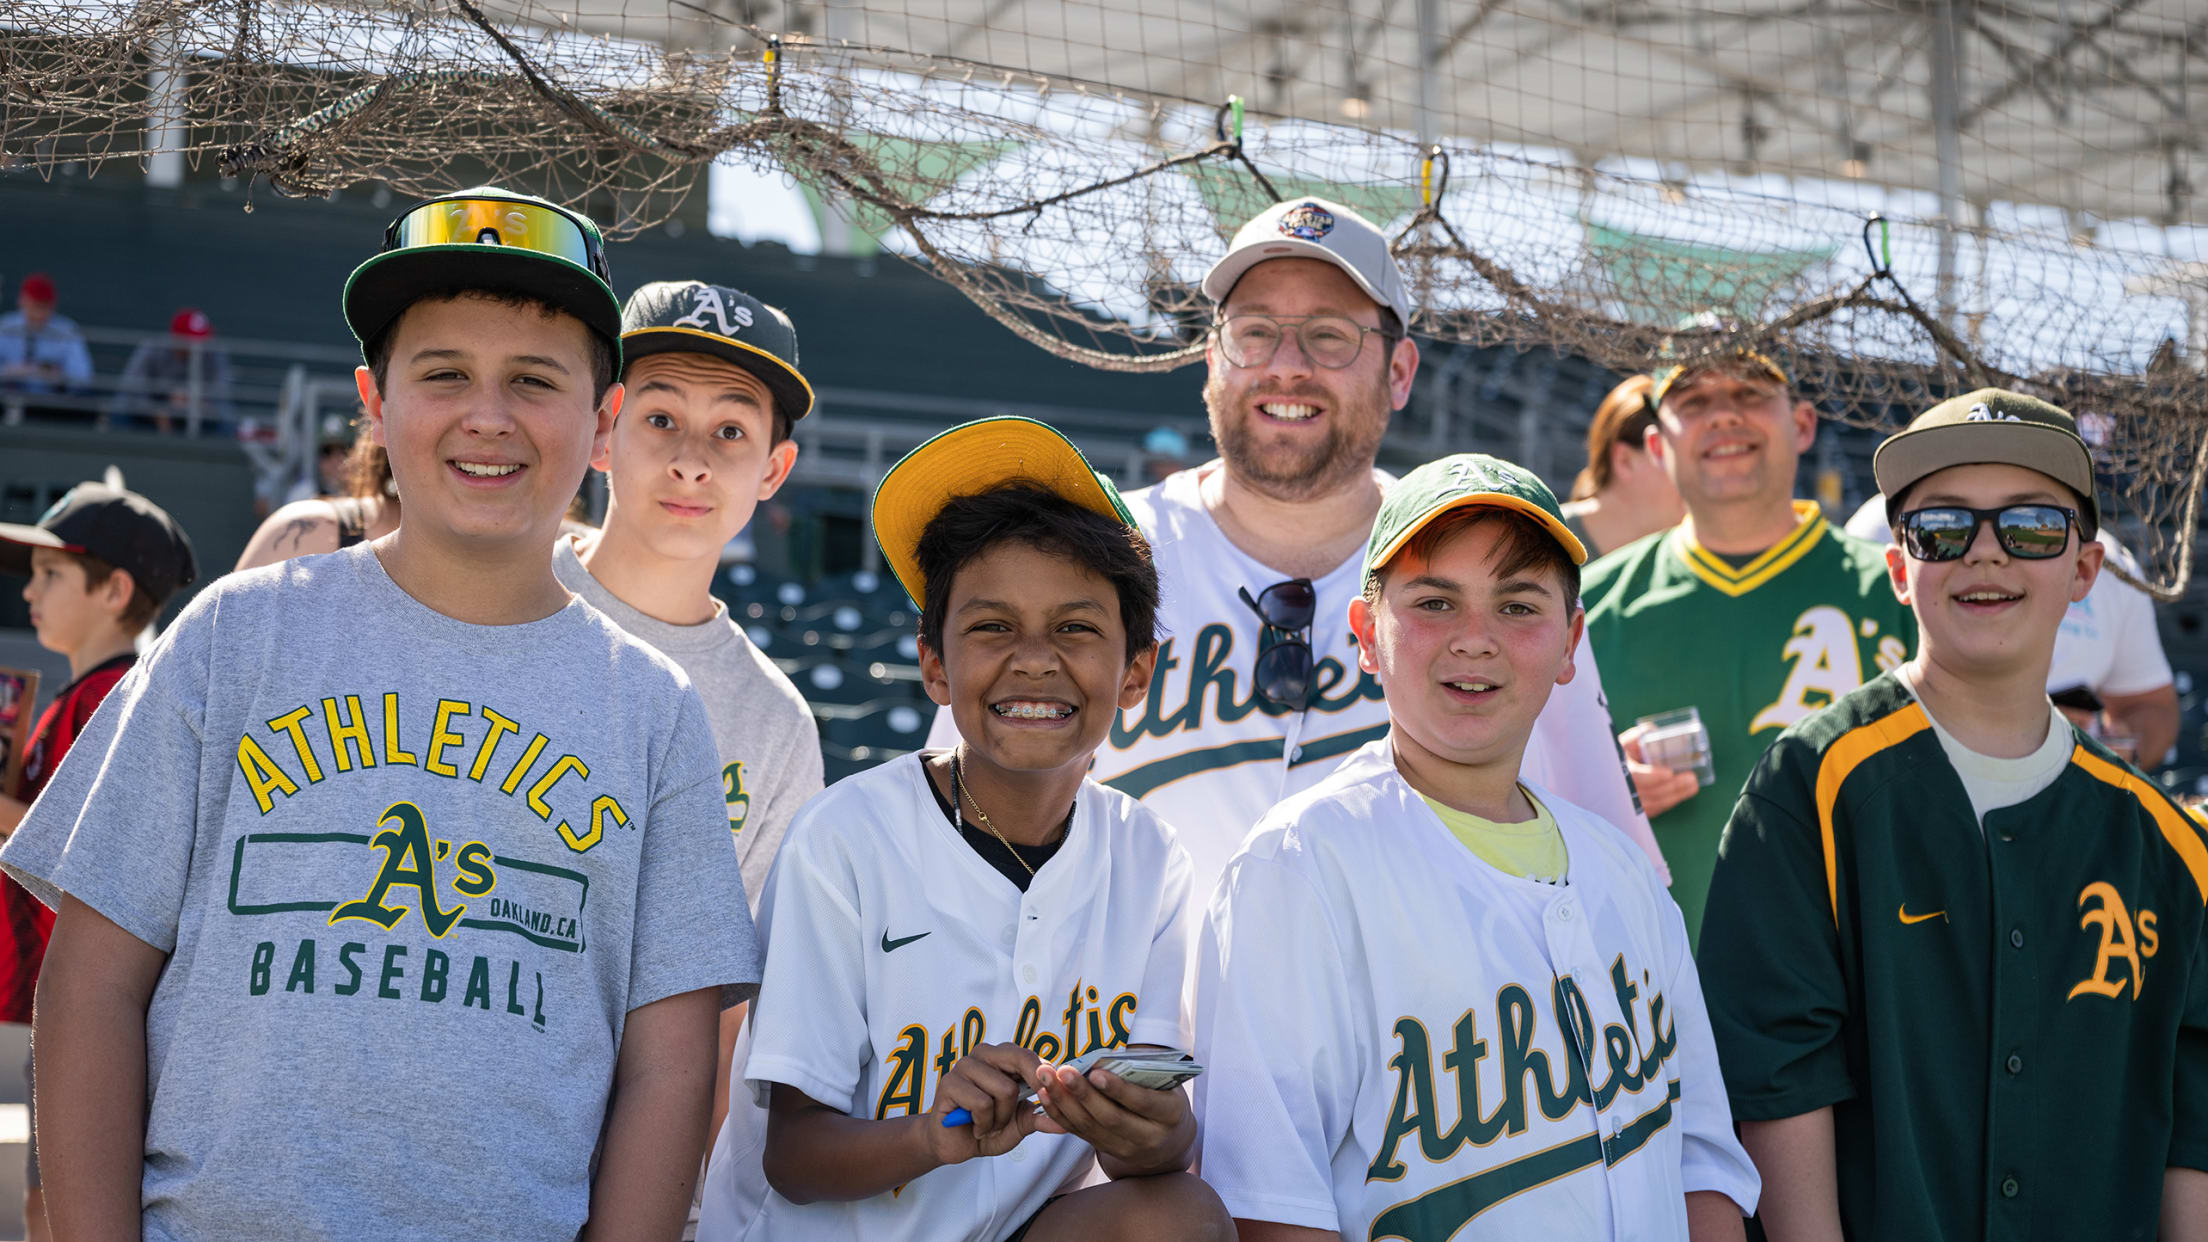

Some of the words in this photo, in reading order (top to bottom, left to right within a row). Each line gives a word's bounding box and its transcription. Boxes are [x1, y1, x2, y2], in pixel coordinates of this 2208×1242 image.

[672, 287, 754, 337] A's
[1966, 402, 2022, 422] A'
[1436, 459, 1521, 500] A's
[1749, 605, 1907, 736] A's
[236, 692, 630, 855] ATHLETICS
[328, 801, 497, 939] A's
[250, 938, 547, 1026] BASEBALL
[1364, 952, 1678, 1186] Athleti
